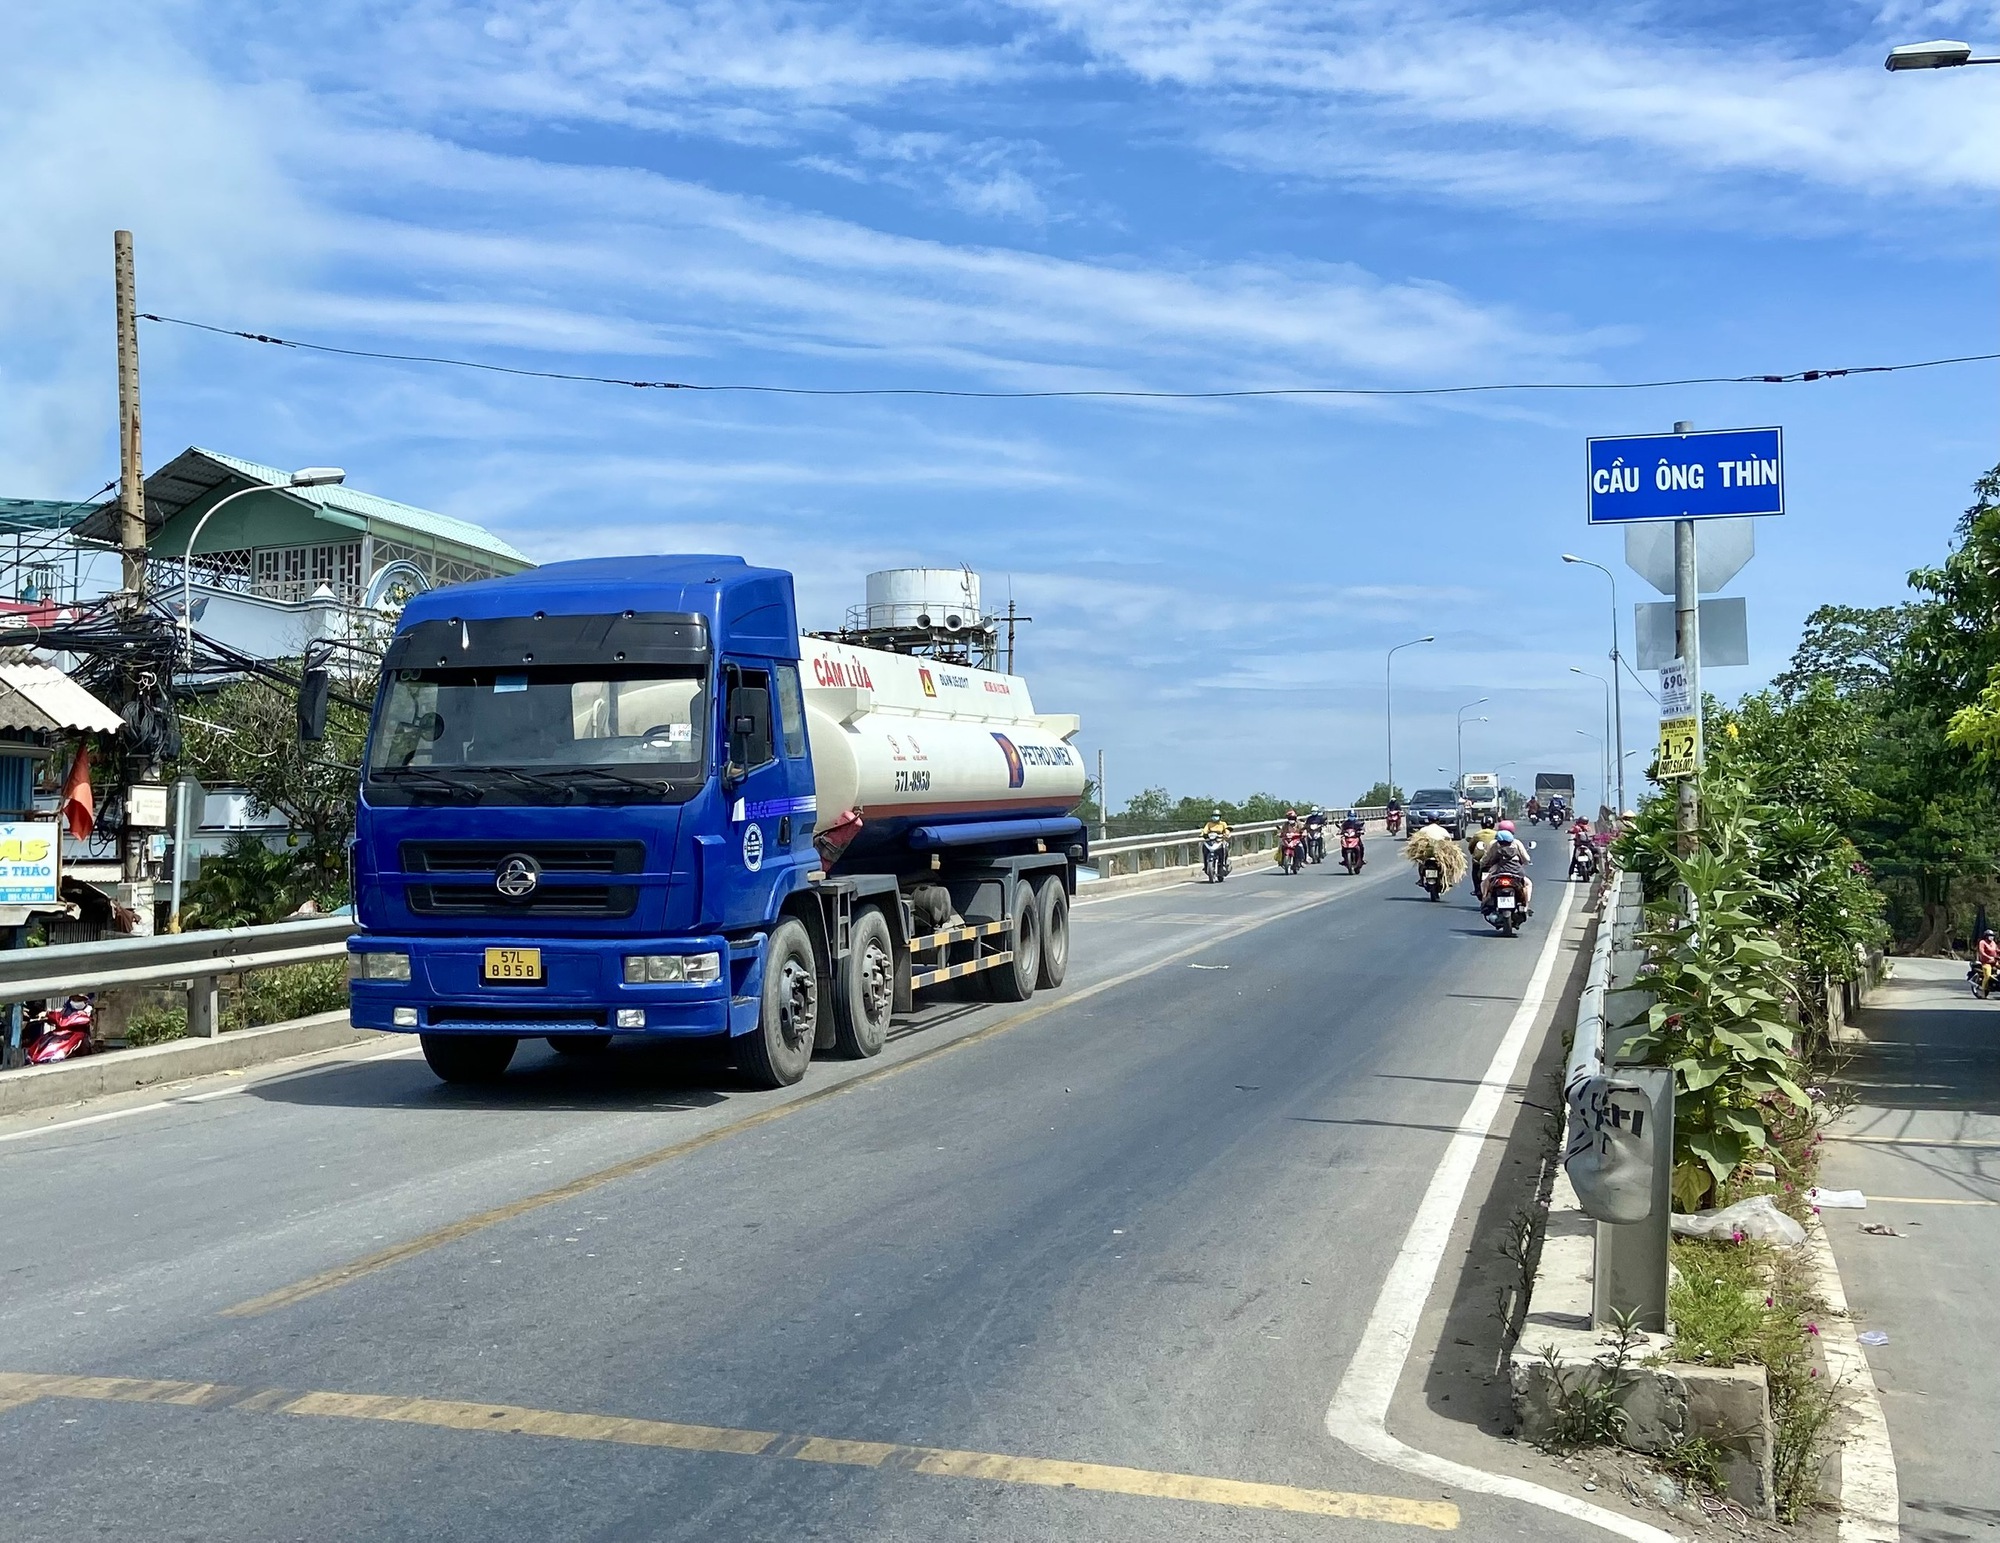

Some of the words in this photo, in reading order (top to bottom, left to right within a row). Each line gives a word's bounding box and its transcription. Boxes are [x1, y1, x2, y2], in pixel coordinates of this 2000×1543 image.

[1593, 457, 1639, 494] CẦU
[1655, 458, 1704, 491] ÔNG
[1718, 453, 1777, 488] THÌN
[814, 652, 846, 687] CẤM
[1017, 745, 1075, 767] PETROLIMEX
[1663, 739, 1672, 760] 1
[1683, 736, 1694, 757] 2
[12, 864, 51, 877] THẢO
[501, 951, 524, 964] 57L
[492, 964, 534, 977] 8958
